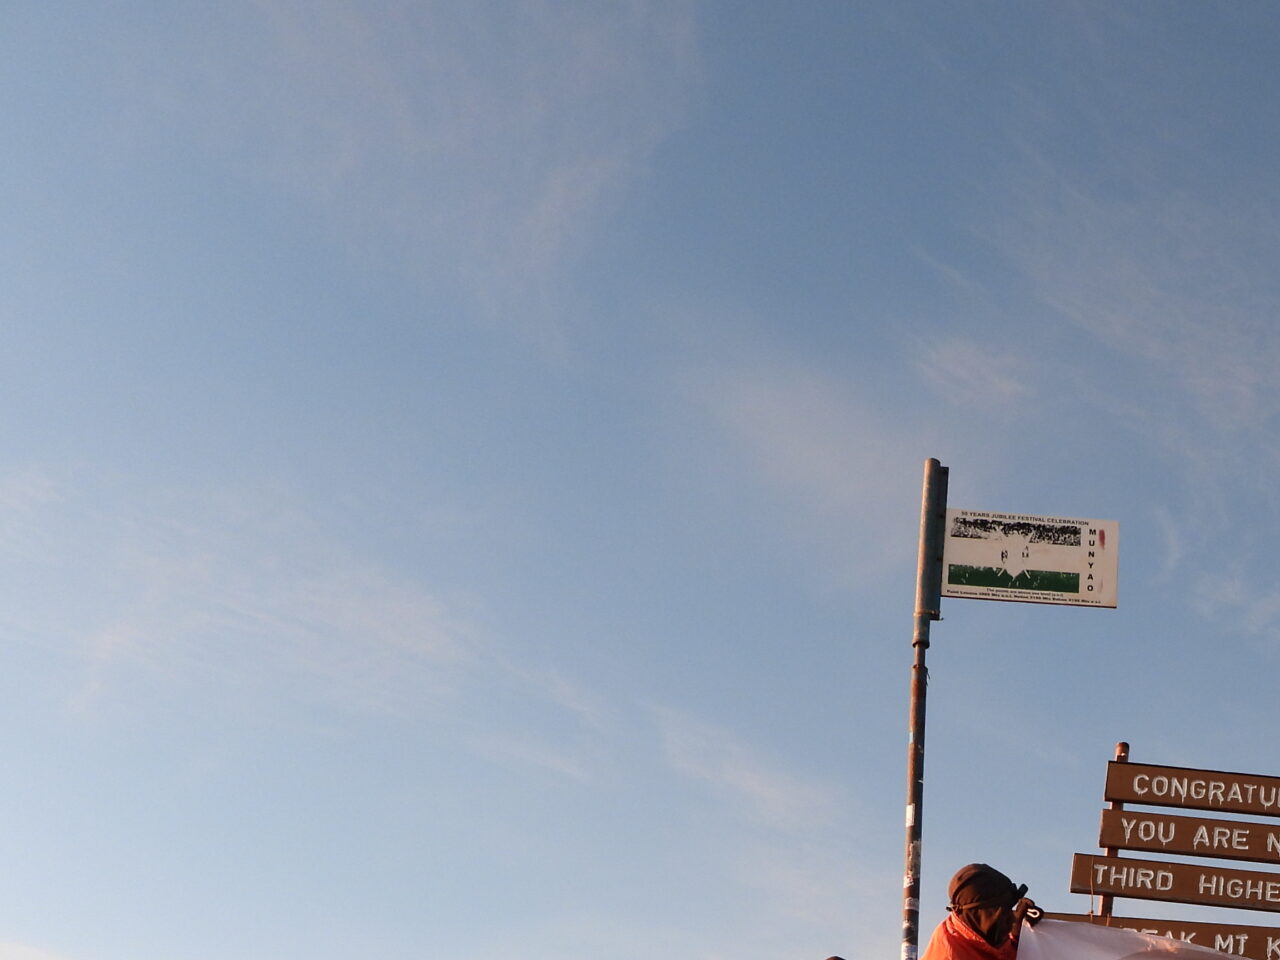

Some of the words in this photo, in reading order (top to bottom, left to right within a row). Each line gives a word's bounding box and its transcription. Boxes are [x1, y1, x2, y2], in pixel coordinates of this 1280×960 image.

[1047, 518, 1089, 526] CELEBRATION
[1121, 818, 1175, 844] YOU
[1193, 825, 1249, 850] ARE
[1094, 864, 1174, 890] THIRD
[1215, 933, 1249, 955] MT
